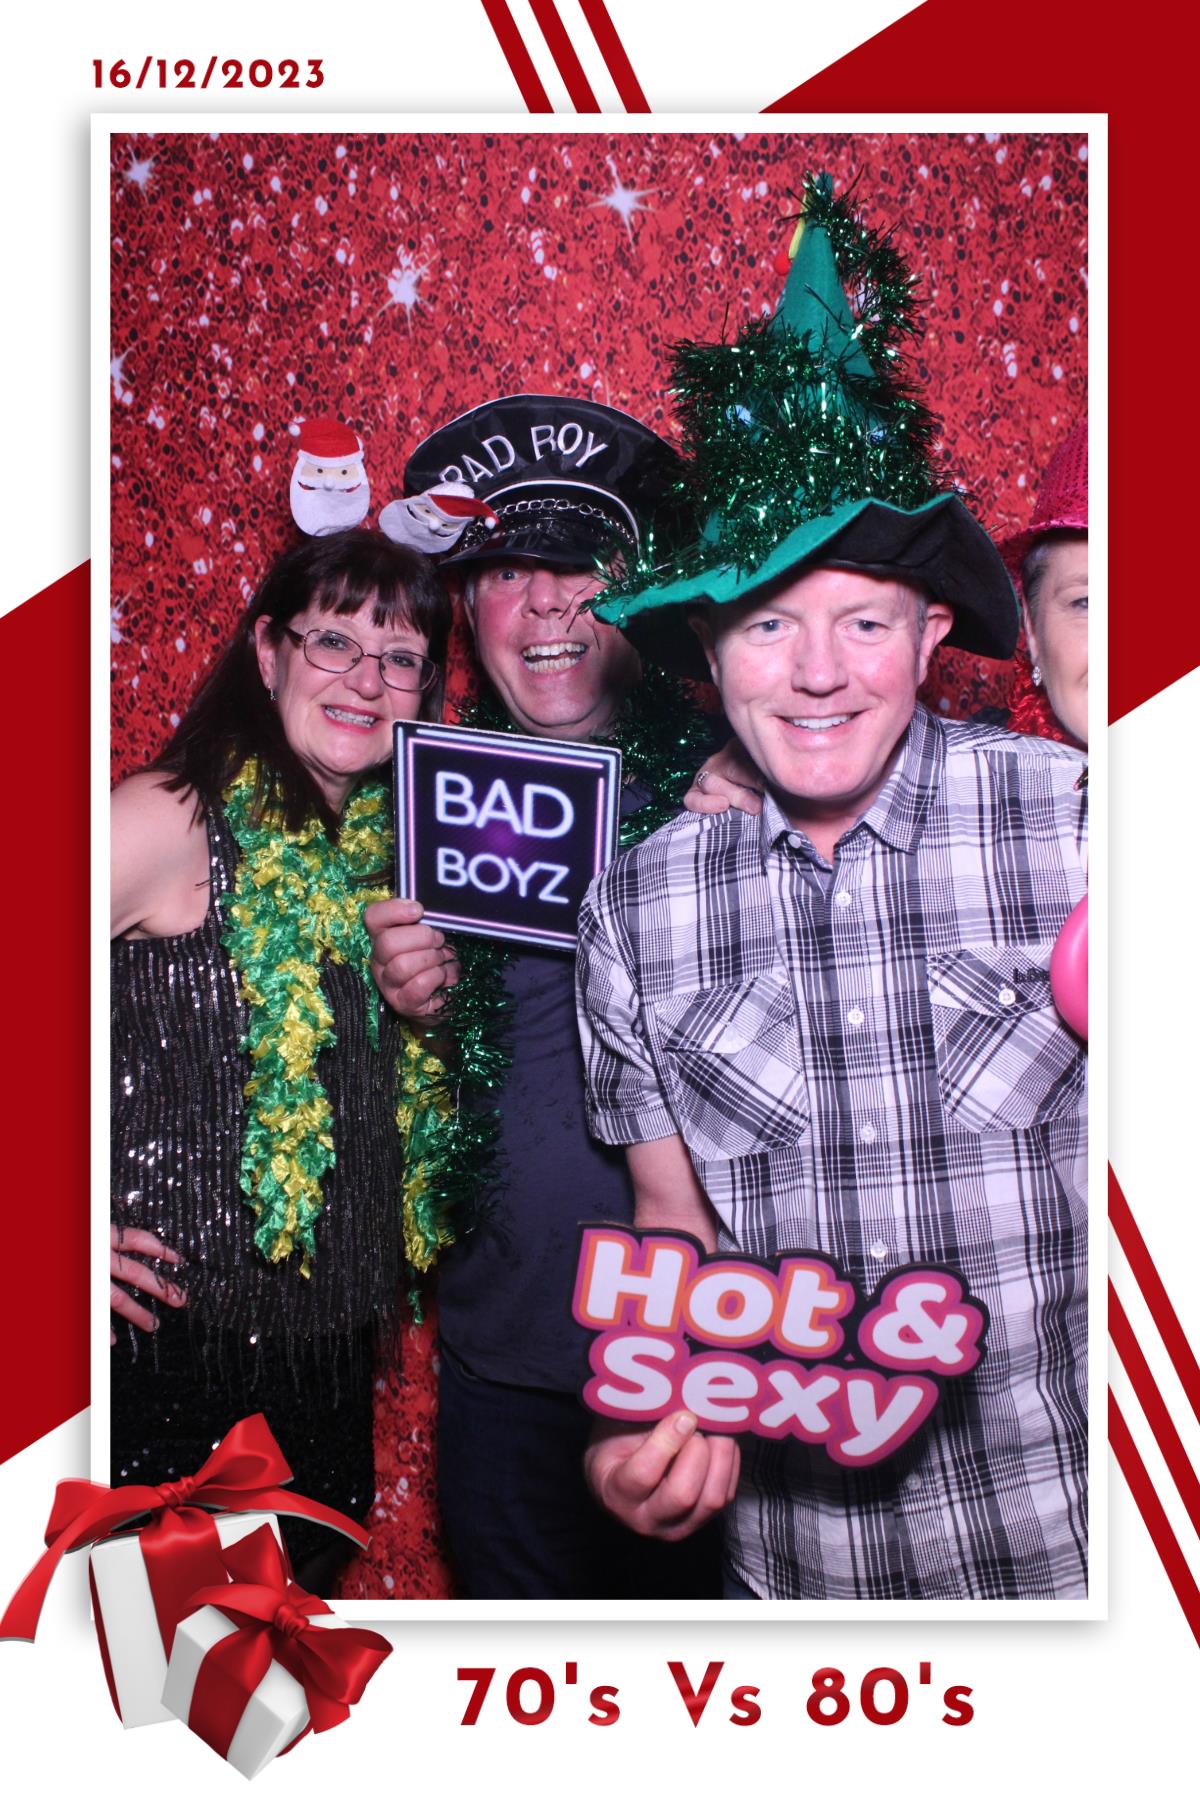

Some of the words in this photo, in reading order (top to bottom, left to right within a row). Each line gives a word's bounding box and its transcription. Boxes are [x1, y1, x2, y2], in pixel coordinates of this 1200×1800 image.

[435, 771, 574, 839] BAD
[436, 847, 570, 904] BOYZ
[586, 1240, 839, 1348] Hot
[872, 1282, 969, 1365] &
[597, 1335, 924, 1457] Sexy
